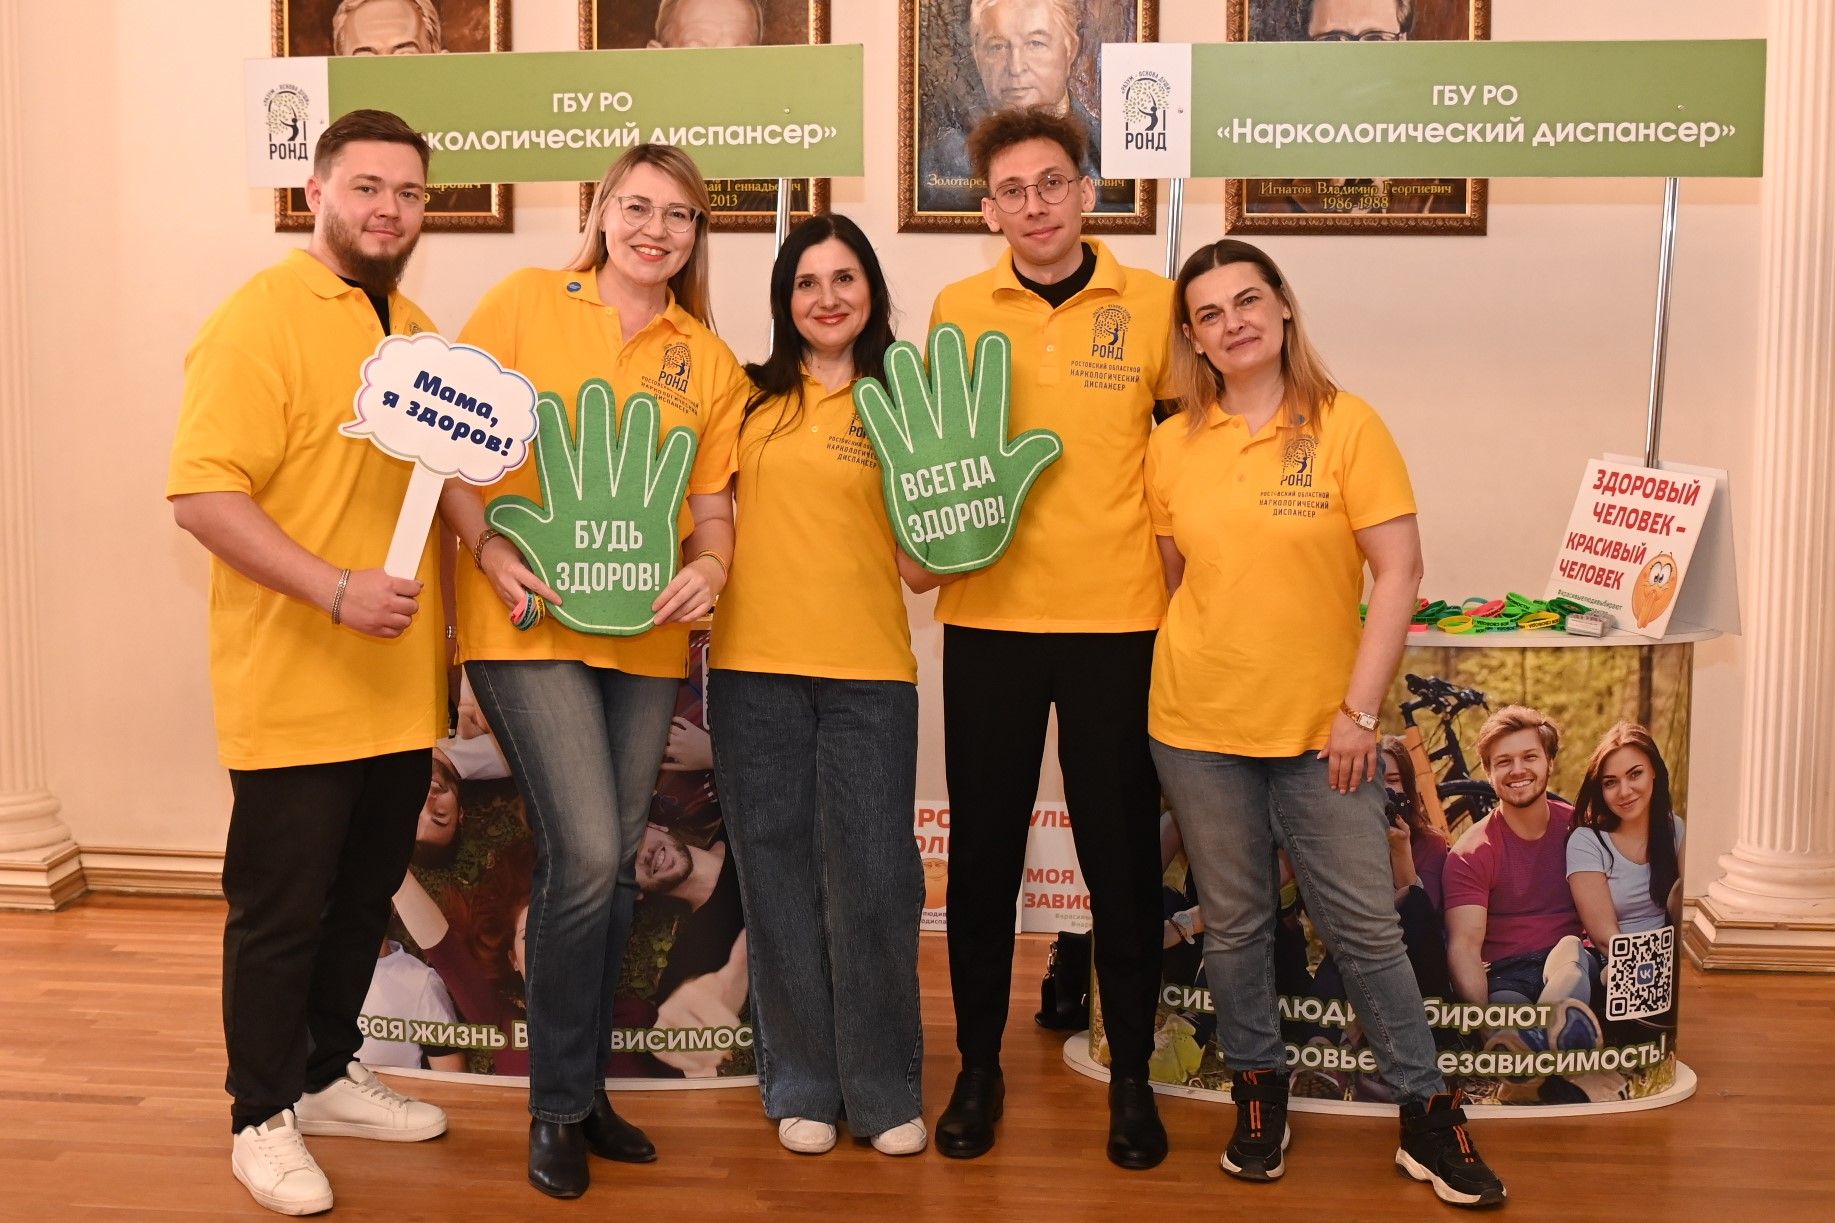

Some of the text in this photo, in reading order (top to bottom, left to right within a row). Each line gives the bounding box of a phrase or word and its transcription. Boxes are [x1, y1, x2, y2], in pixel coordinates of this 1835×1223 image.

[553, 91, 633, 113] ГБУ РО
[1432, 85, 1518, 106] ГБУ РО
[421, 121, 837, 151] кологический диспансер»
[1125, 132, 1167, 152] РОНД
[1217, 116, 1736, 149] «Наркологический диспансер»
[269, 142, 309, 161] РОНД
[1261, 180, 1452, 197] Игнатов Владимир Георгиевич
[1322, 196, 1389, 210] 1986-1988
[1091, 344, 1123, 361] РОНД
[658, 371, 689, 394] РОНД
[1070, 368, 1140, 384] НАРКОЛОГИЧЕСКИЙ
[1083, 379, 1126, 391] ДИСПАНСЕР
[413, 370, 499, 428] Мама,
[382, 391, 513, 457] я здоров!
[900, 455, 996, 502] ВСЕГДА
[1592, 468, 1702, 507] ЗДОРОВЫЙ
[1259, 499, 1329, 510] НАРКОЛОГИЧЕСКИЙ
[1272, 508, 1316, 518] ДИСПАНСЕР
[907, 495, 1006, 543] ЗДОРОВ!
[575, 520, 643, 552] БУДЬ
[1565, 531, 1648, 566] КРАСИВЫЙ
[556, 562, 660, 594] ЗДОРОВ!
[1559, 558, 1625, 591] ЧЕЛОВЕК
[1026, 868, 1075, 885] МОЯ
[410, 1022, 506, 1048] жизнь
[1437, 1034, 1666, 1074] езависимость!
